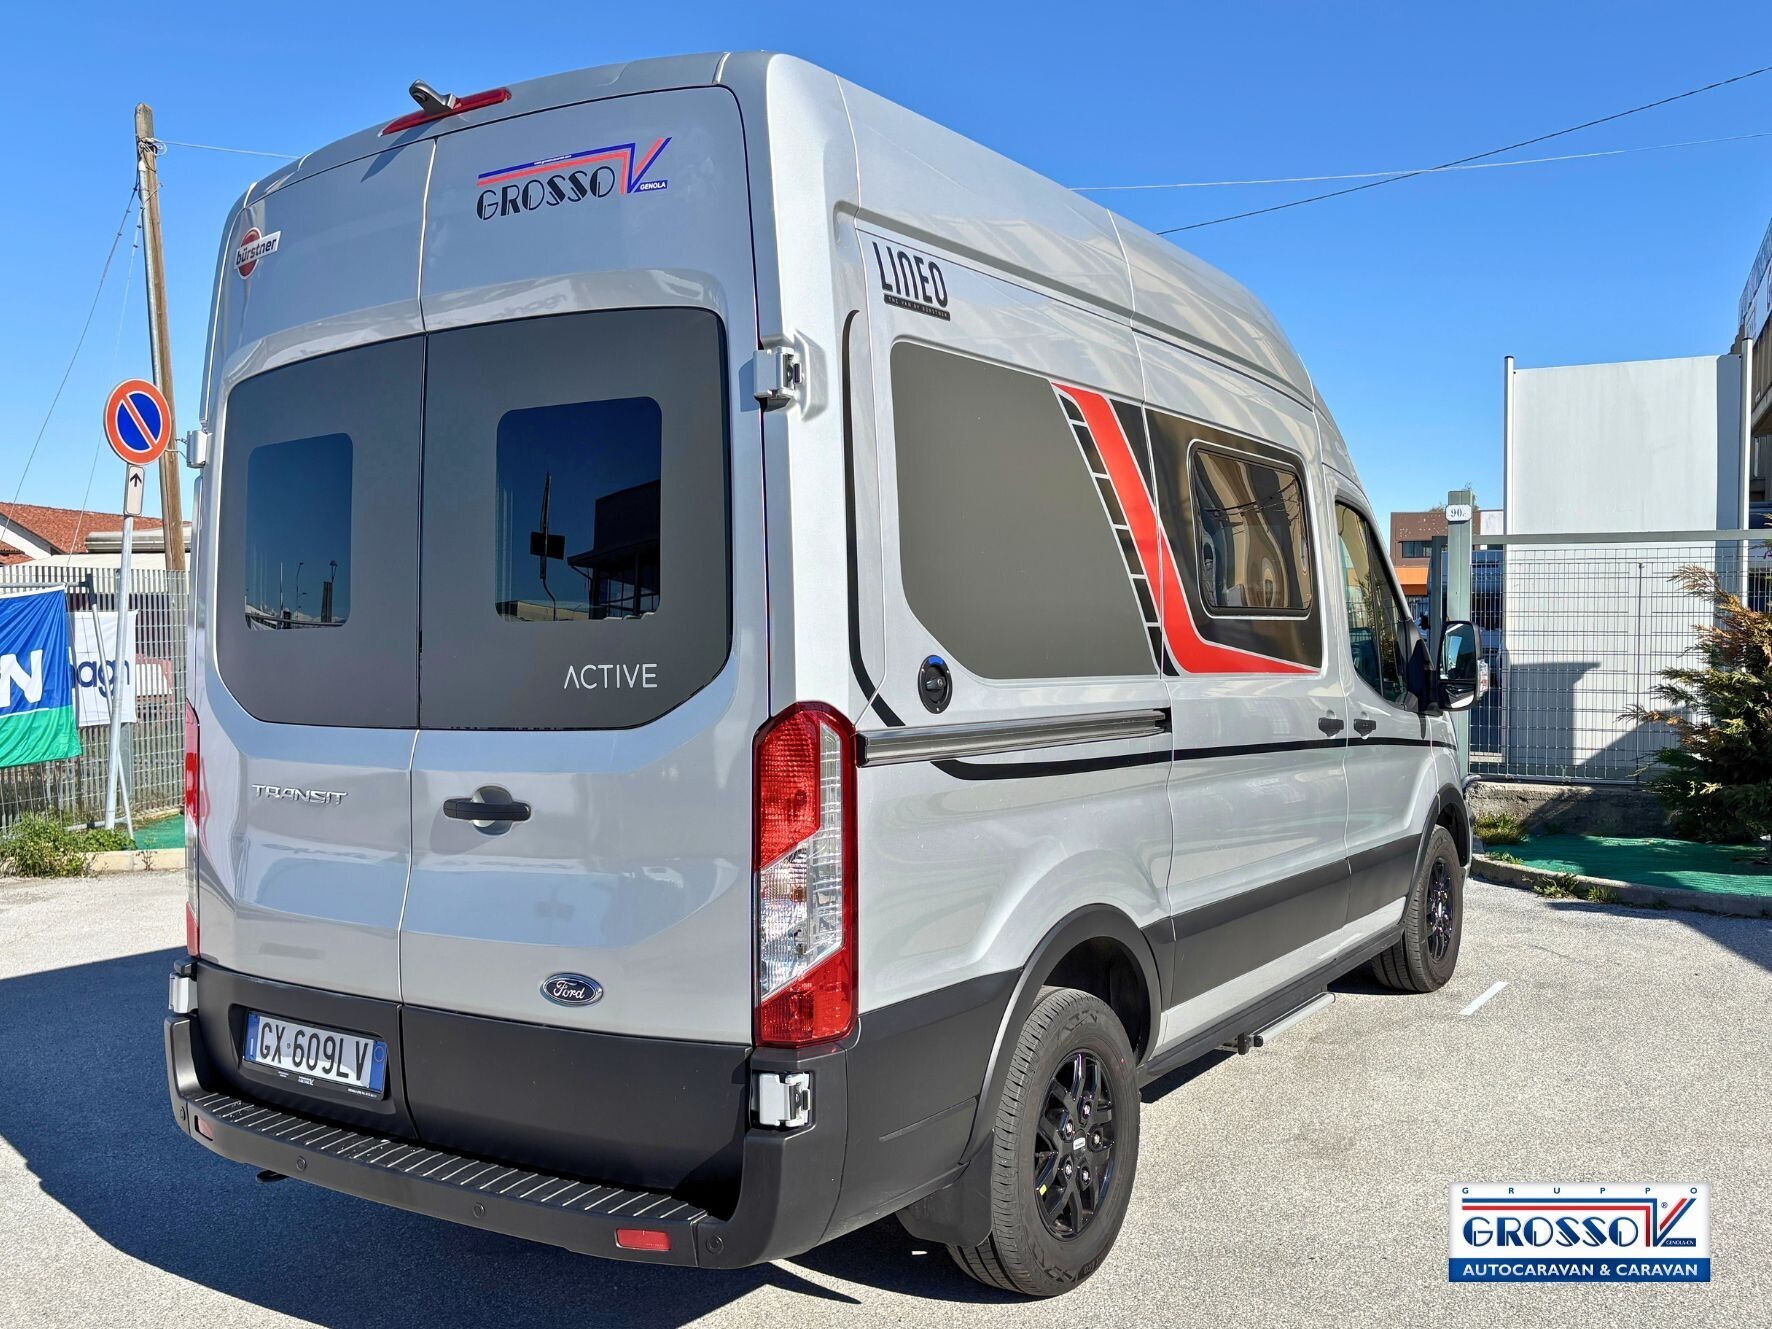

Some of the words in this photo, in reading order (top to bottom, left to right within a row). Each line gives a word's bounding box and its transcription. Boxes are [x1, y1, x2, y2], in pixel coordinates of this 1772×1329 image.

[476, 165, 616, 221] GROSSO
[639, 181, 666, 191] GENOLA
[236, 238, 277, 266] bürstner
[563, 663, 658, 690] ACTIVE
[251, 783, 349, 806] TRANSIT
[553, 980, 586, 999] Ford
